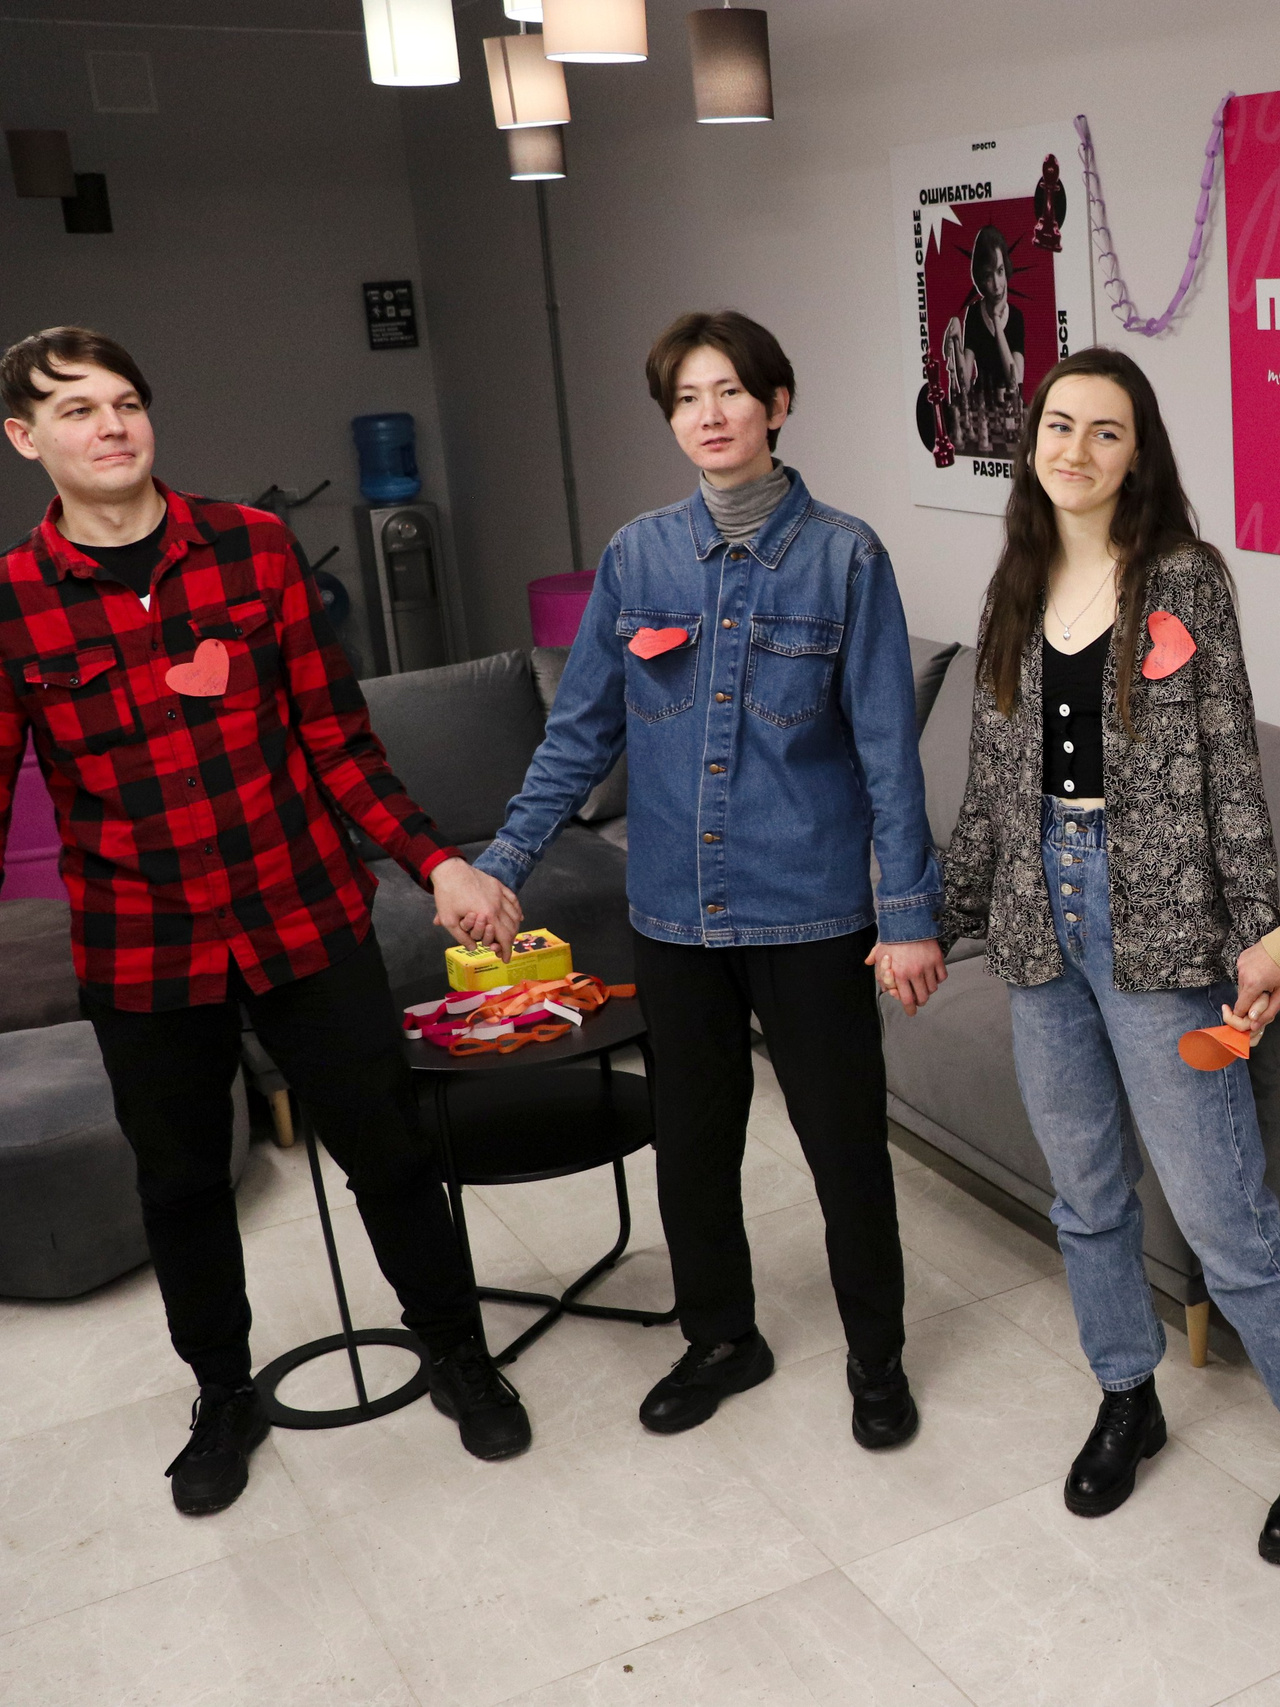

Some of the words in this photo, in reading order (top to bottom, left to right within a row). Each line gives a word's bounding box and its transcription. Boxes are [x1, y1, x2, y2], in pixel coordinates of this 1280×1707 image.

[971, 141, 997, 152] ПРОСТО
[919, 181, 992, 205] ОШИБАТЬСЯ
[913, 209, 924, 266] СЕБЕ
